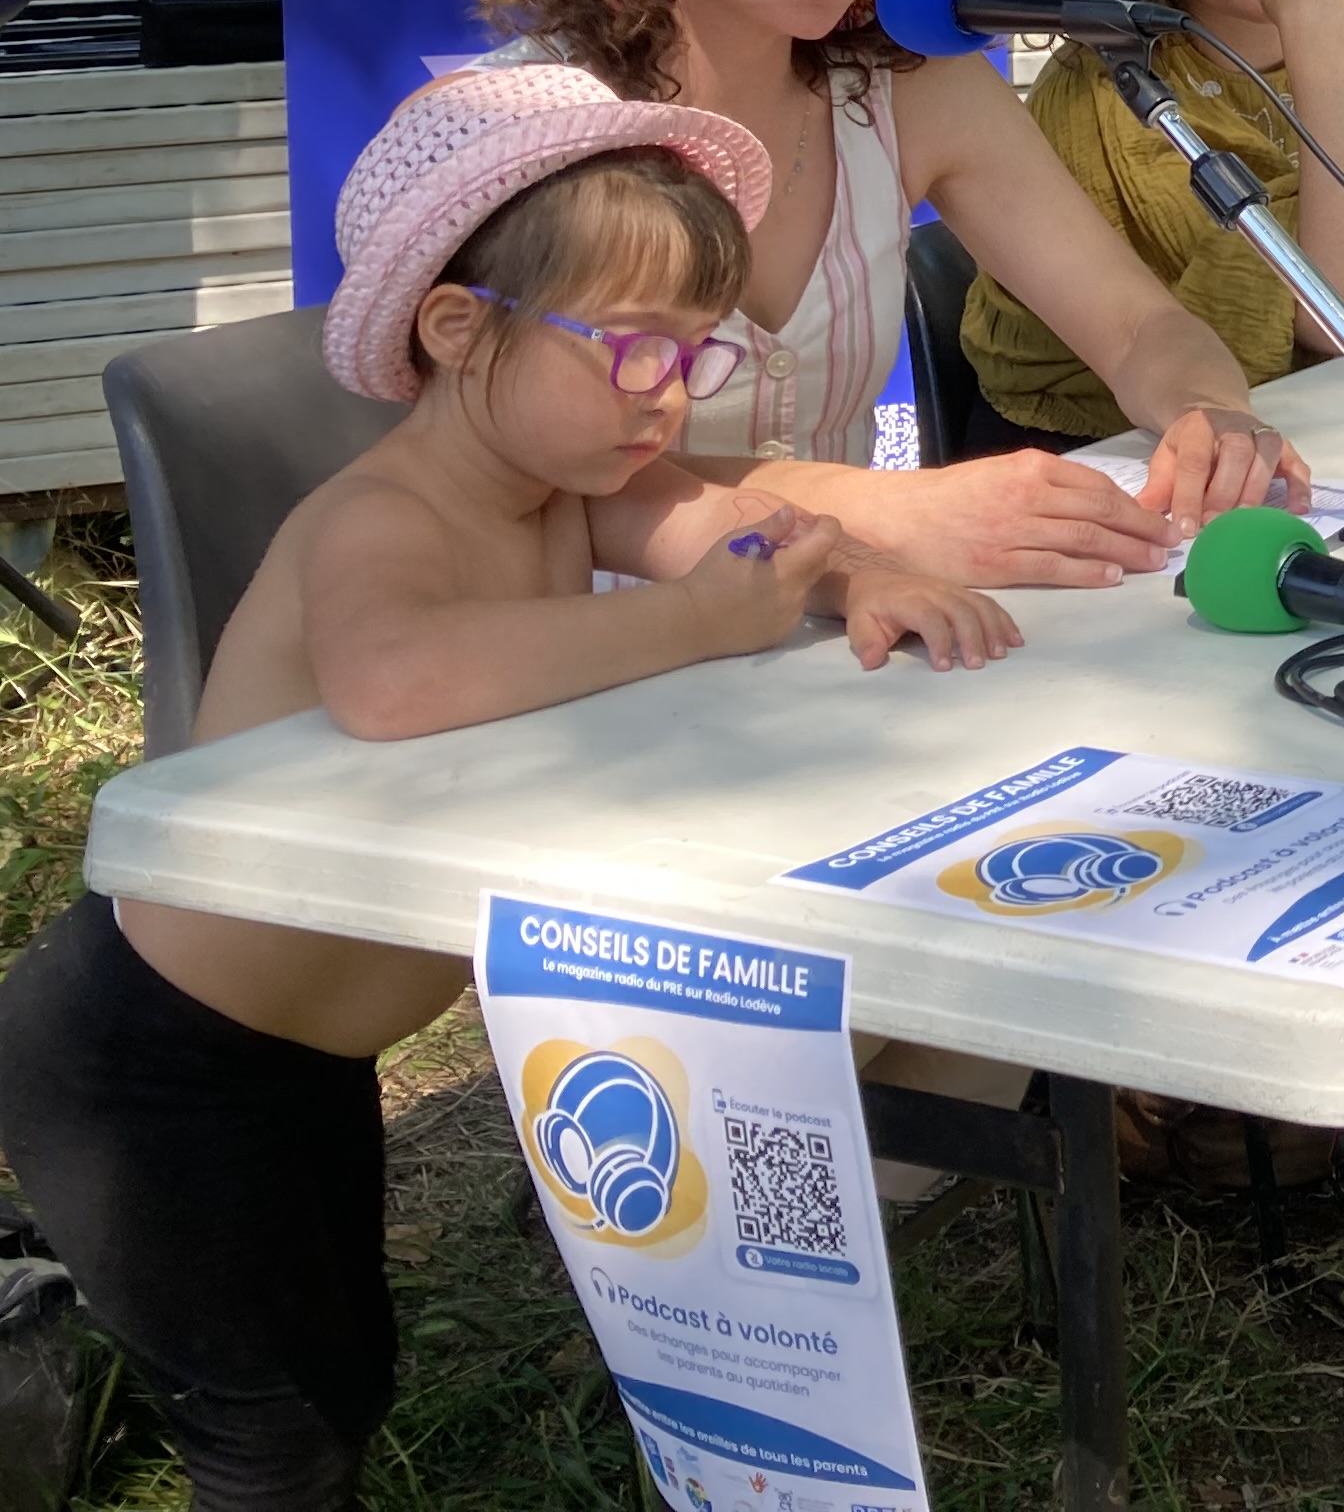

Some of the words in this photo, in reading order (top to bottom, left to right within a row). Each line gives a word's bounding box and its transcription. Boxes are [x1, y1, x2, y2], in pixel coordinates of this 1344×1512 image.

[827, 813, 957, 869] CONSEILS
[953, 798, 994, 817] DE
[991, 755, 1085, 801] FAMILLE
[1186, 857, 1281, 901] Podcast
[519, 915, 650, 967] CONSEILS
[656, 940, 692, 975] DE
[698, 947, 809, 998] FAMILLE
[542, 957, 556, 971] Le
[557, 961, 613, 983] magazine
[614, 970, 644, 988] radio
[645, 977, 661, 992] du
[663, 981, 683, 996] PRE
[685, 986, 703, 1000] sur
[705, 989, 738, 1007] Radio
[740, 996, 781, 1016] Lodève
[785, 1110, 833, 1129] podcast
[616, 1284, 712, 1333] Podcast
[716, 1311, 732, 1337] à
[737, 1320, 839, 1356] volonté
[676, 1355, 724, 1381] parents
[726, 1369, 743, 1385] au
[745, 1373, 811, 1398] quotidien
[711, 1347, 741, 1365] pour
[743, 1357, 841, 1384] accompagner
[759, 1449, 789, 1465] tous
[812, 1458, 869, 1477] parents
